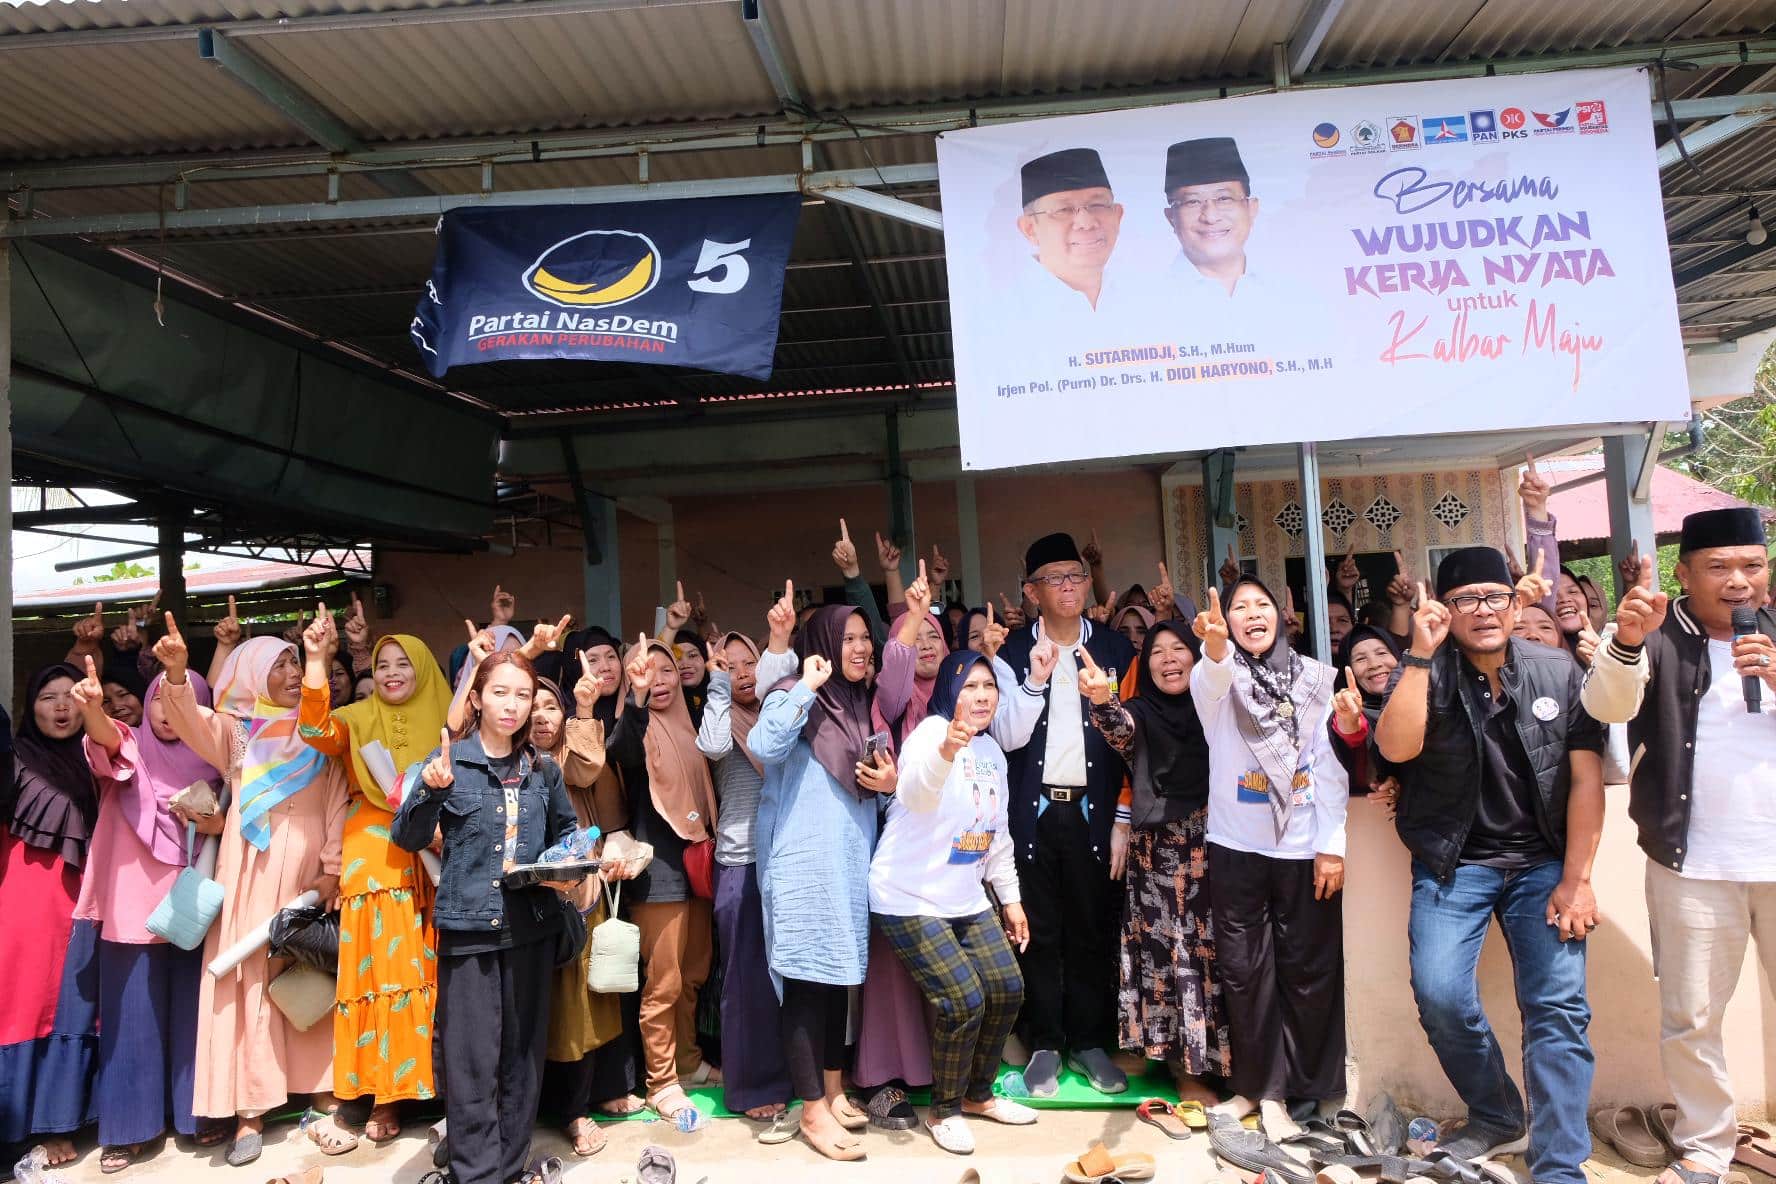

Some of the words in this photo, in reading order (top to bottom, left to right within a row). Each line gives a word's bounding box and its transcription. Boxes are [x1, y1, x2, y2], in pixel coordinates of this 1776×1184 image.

[1472, 132, 1498, 142] PAN
[1502, 129, 1529, 140] PKS
[1374, 166, 1559, 215] Bersama
[1350, 210, 1592, 257] WUJUDKAN
[687, 237, 752, 295] 5
[1343, 258, 1471, 300] KERJA
[1482, 248, 1617, 289] NYATA
[1447, 290, 1519, 312] untuk
[468, 310, 550, 337] Partai
[556, 311, 678, 339] NasDem
[476, 334, 553, 353] GERAKAN
[557, 334, 665, 353] PERUBAHAN
[1068, 355, 1082, 368] H.
[1085, 345, 1177, 367] SUTARMIDJI,
[1178, 344, 1208, 359] S.H.,
[1210, 341, 1256, 355] M.Hum
[1379, 304, 1512, 367] Kalbar
[1522, 298, 1603, 393] Maju
[997, 383, 1026, 400] Irjen
[1029, 378, 1054, 394] Pol.
[1057, 376, 1097, 394] (Purn)
[1100, 373, 1117, 388] Dr.
[1121, 371, 1147, 385] Drs.
[1150, 370, 1163, 383] H.
[1166, 365, 1197, 382] DIDI
[1200, 361, 1273, 379] HARYONO,
[1276, 358, 1306, 375] S.H.,
[1308, 357, 1333, 371] M.H
